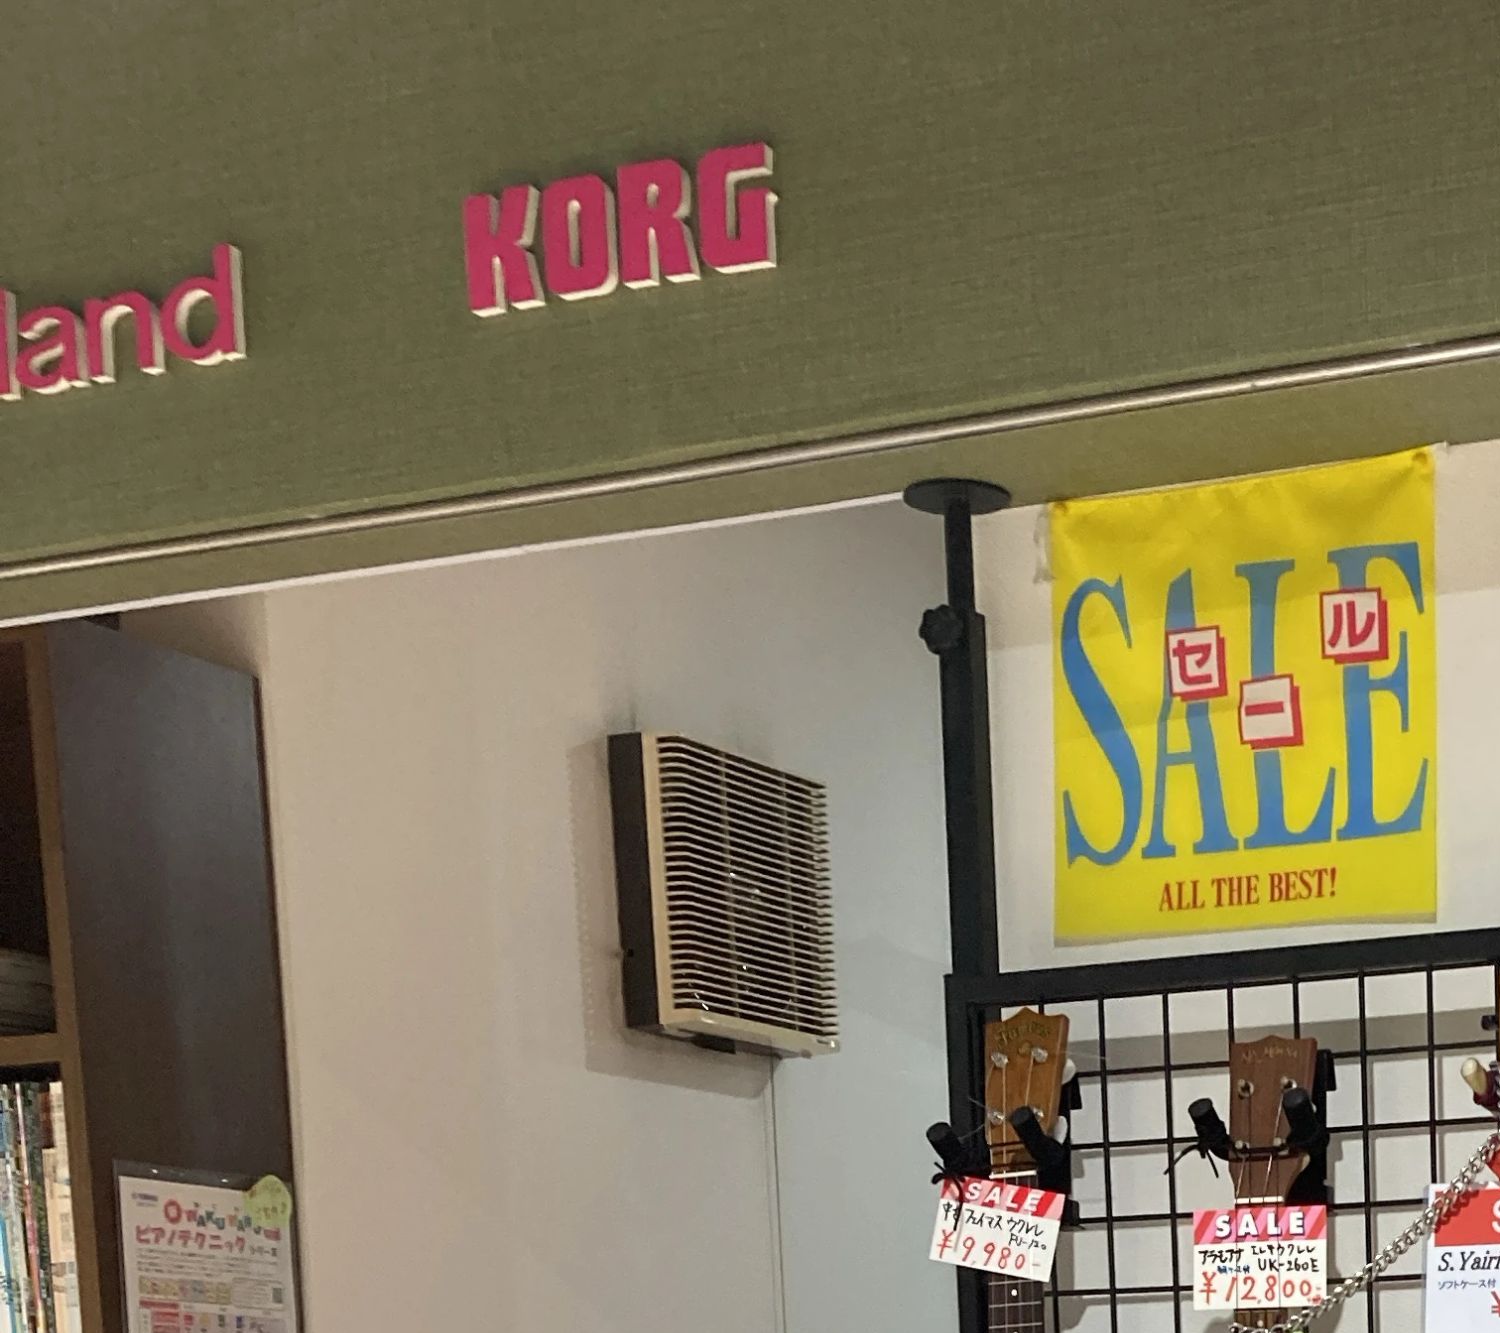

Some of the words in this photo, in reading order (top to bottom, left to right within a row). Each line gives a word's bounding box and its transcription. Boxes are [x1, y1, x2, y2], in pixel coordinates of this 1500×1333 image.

[463, 142, 778, 317] KORG
[1061, 542, 1429, 868] SALE
[1159, 880, 1206, 912] ALL
[1211, 874, 1260, 906] THE
[1268, 867, 1338, 903] BEST!
[964, 1181, 1043, 1213] SALE
[1215, 1210, 1306, 1239] SALE
[1257, 1257, 1321, 1273] UK-260E
[1437, 1278, 1497, 1291] ソフトケース付
